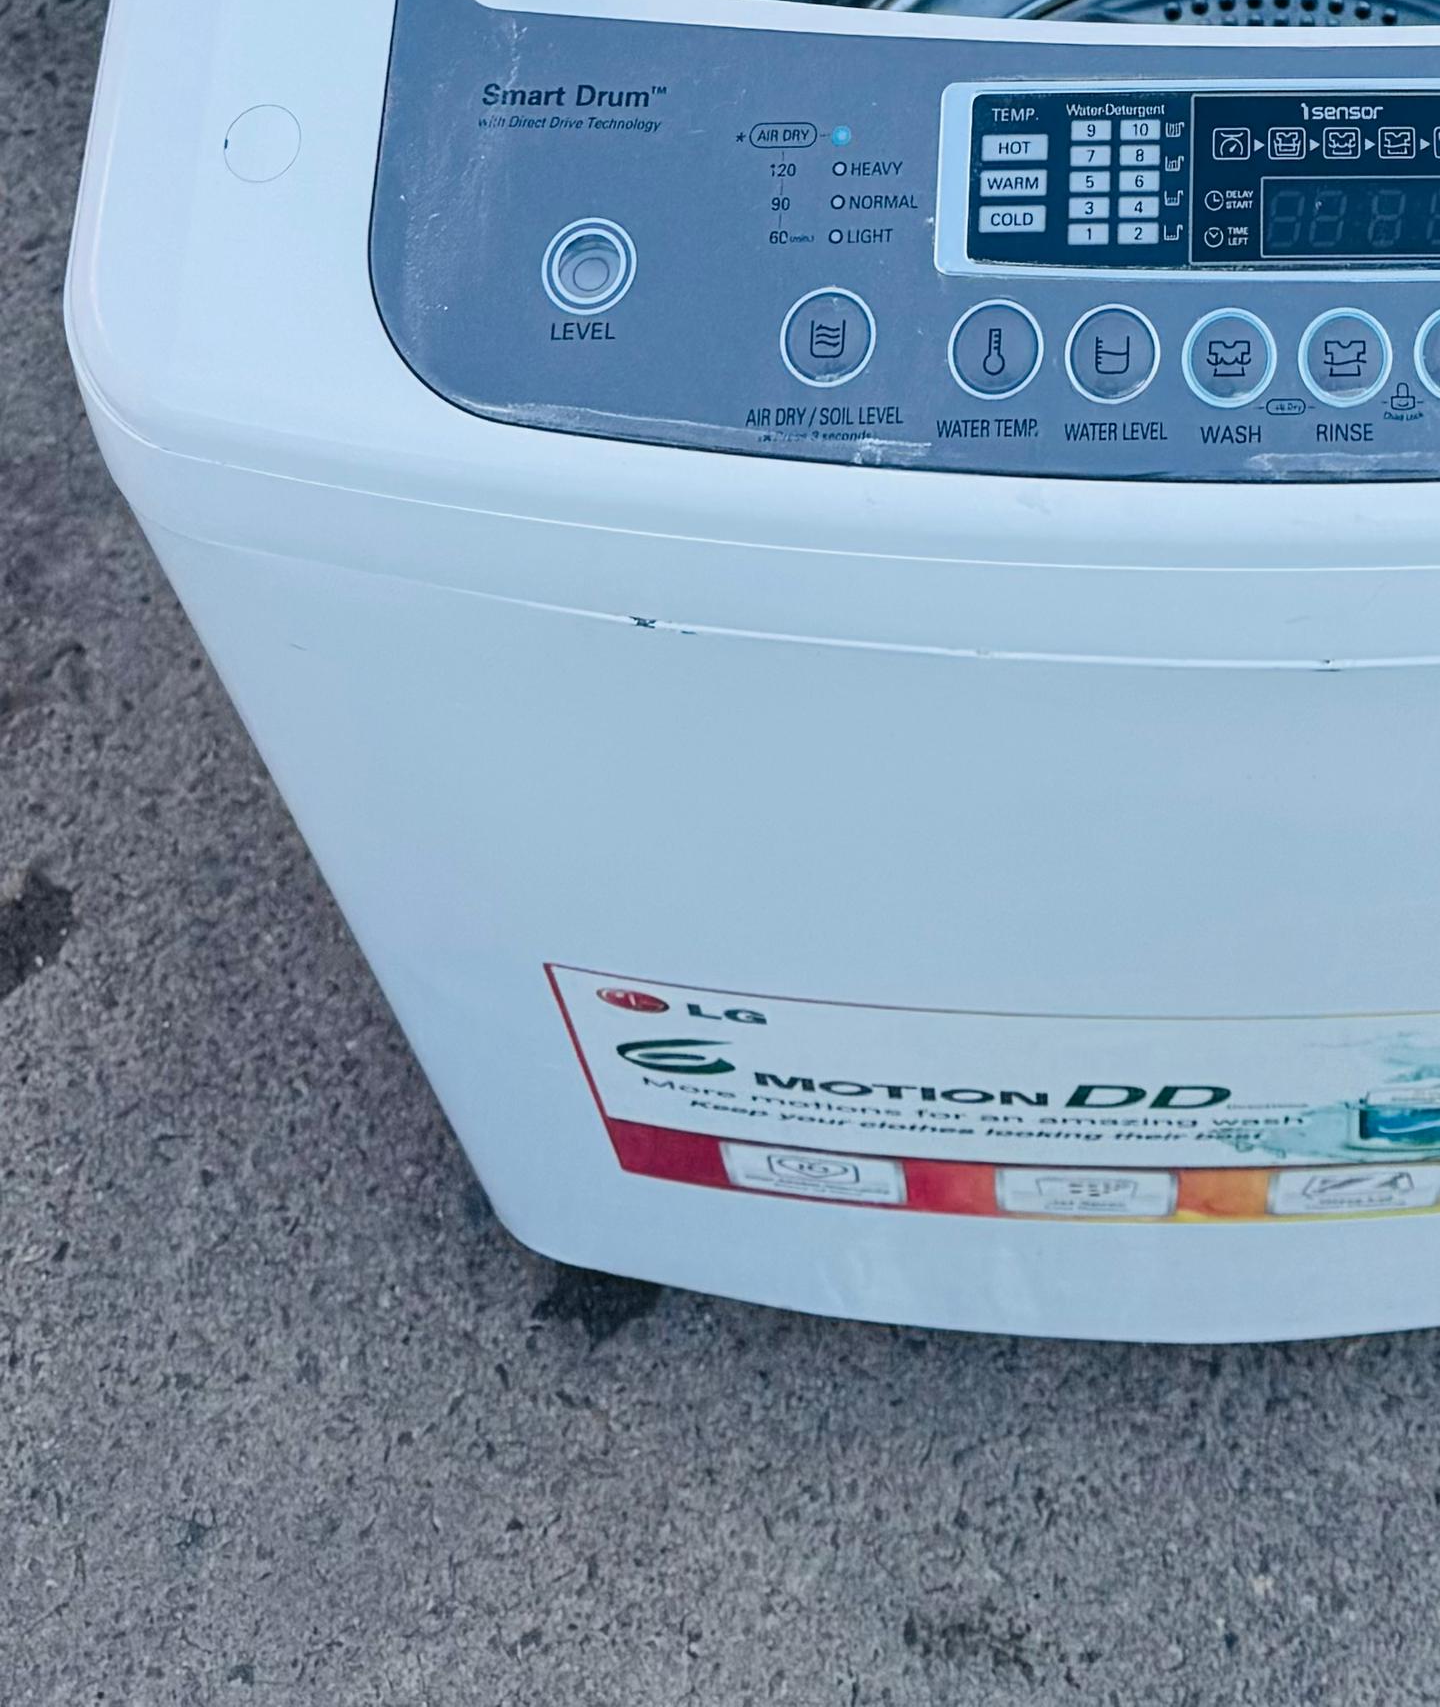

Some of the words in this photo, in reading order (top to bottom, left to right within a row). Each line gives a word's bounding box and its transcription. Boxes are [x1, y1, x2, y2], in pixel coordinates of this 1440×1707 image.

[482, 83, 566, 106] Smart
[992, 107, 1039, 122] TEMP.
[508, 115, 546, 128] Direct
[549, 116, 583, 129] Drive
[588, 117, 661, 132] Technology
[1087, 124, 1096, 137] 9
[1132, 123, 1149, 136] 10
[757, 130, 779, 142] AIR
[783, 129, 810, 141] DRY
[998, 141, 1032, 155] HOT
[1087, 150, 1096, 163] 7
[1135, 149, 1144, 162] 8
[770, 163, 797, 177] 120
[851, 161, 903, 177] HEAVY
[987, 176, 1040, 190] WARM
[1085, 175, 1095, 189] 5
[1135, 175, 1144, 188] 6
[1226, 190, 1254, 199] DELAY
[771, 197, 791, 211] 90
[850, 194, 919, 210] NORMAL
[1084, 202, 1094, 215] 3
[1134, 201, 1143, 214] 4
[1226, 200, 1253, 209] START
[991, 212, 1034, 227] COLD
[769, 230, 789, 245] 60
[847, 228, 893, 244] LIGHT
[1086, 227, 1093, 241] 1
[1133, 226, 1143, 240] 2
[1228, 226, 1249, 235] TIME
[1228, 237, 1249, 246] LEFT
[550, 322, 616, 341] LEVEL
[746, 408, 771, 426] AIR
[775, 407, 806, 426] DRY
[819, 407, 855, 425] SOIL
[858, 406, 904, 425] LEVEL
[936, 419, 990, 438] WATER
[994, 418, 1038, 437] TEMP.
[1064, 422, 1117, 441] WATER
[1122, 422, 1168, 440] LEVEL
[1200, 425, 1261, 444] WASH
[1316, 423, 1374, 441] RINSE
[687, 1003, 767, 1025] LG
[754, 1071, 1048, 1106] MOTION
[1065, 1084, 1232, 1109] DD
[643, 1076, 736, 1098] More
[751, 1095, 902, 1117] motions
[916, 1108, 967, 1120] for
[980, 1114, 1023, 1123] an
[1039, 1116, 1198, 1128] amazing
[1212, 1116, 1304, 1126] wash
[691, 1100, 768, 1116] Keep
[780, 1113, 851, 1126] your
[860, 1121, 974, 1134] clothes
[985, 1128, 1103, 1141] looking
[1115, 1132, 1183, 1140] their
